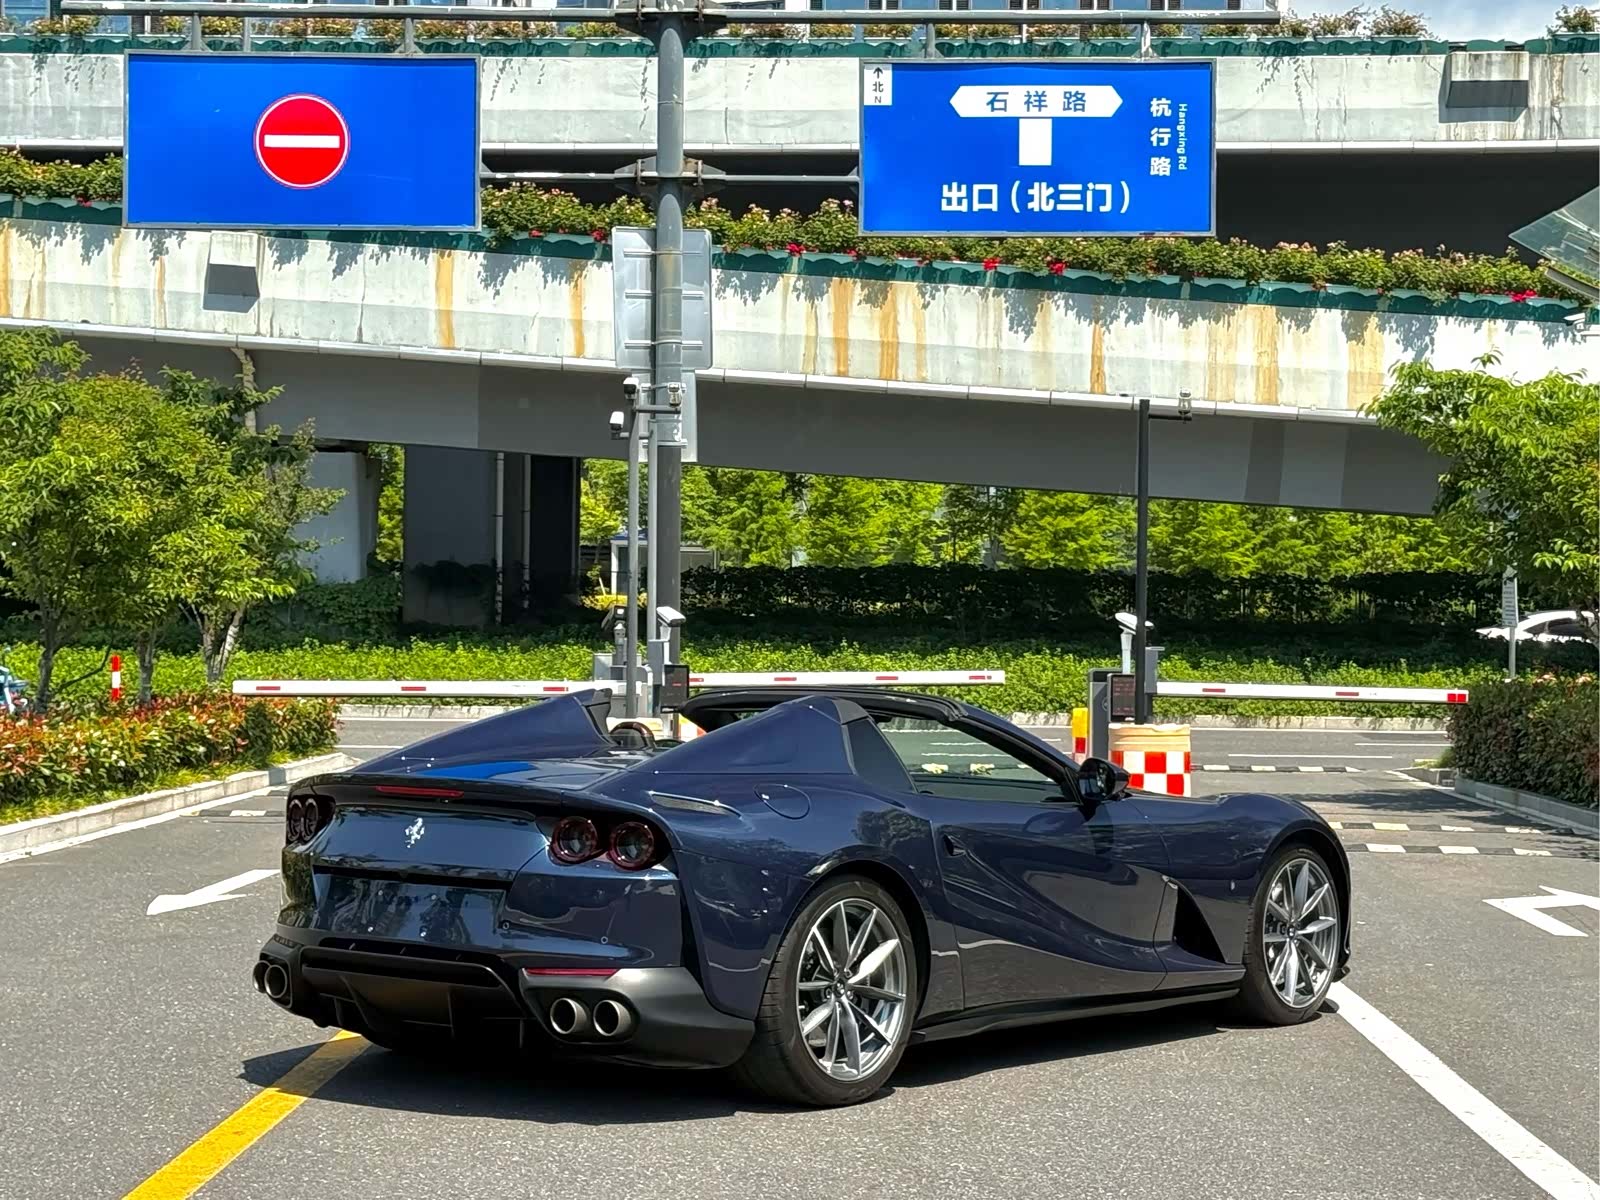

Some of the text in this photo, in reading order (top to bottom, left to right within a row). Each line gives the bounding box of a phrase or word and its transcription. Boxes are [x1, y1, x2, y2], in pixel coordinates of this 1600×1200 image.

[872, 81, 884, 93] 北
[874, 95, 882, 104] N
[986, 90, 1087, 113] 石祥路
[1149, 97, 1172, 177] 杭行路
[1176, 103, 1188, 170] Hangxing Rd
